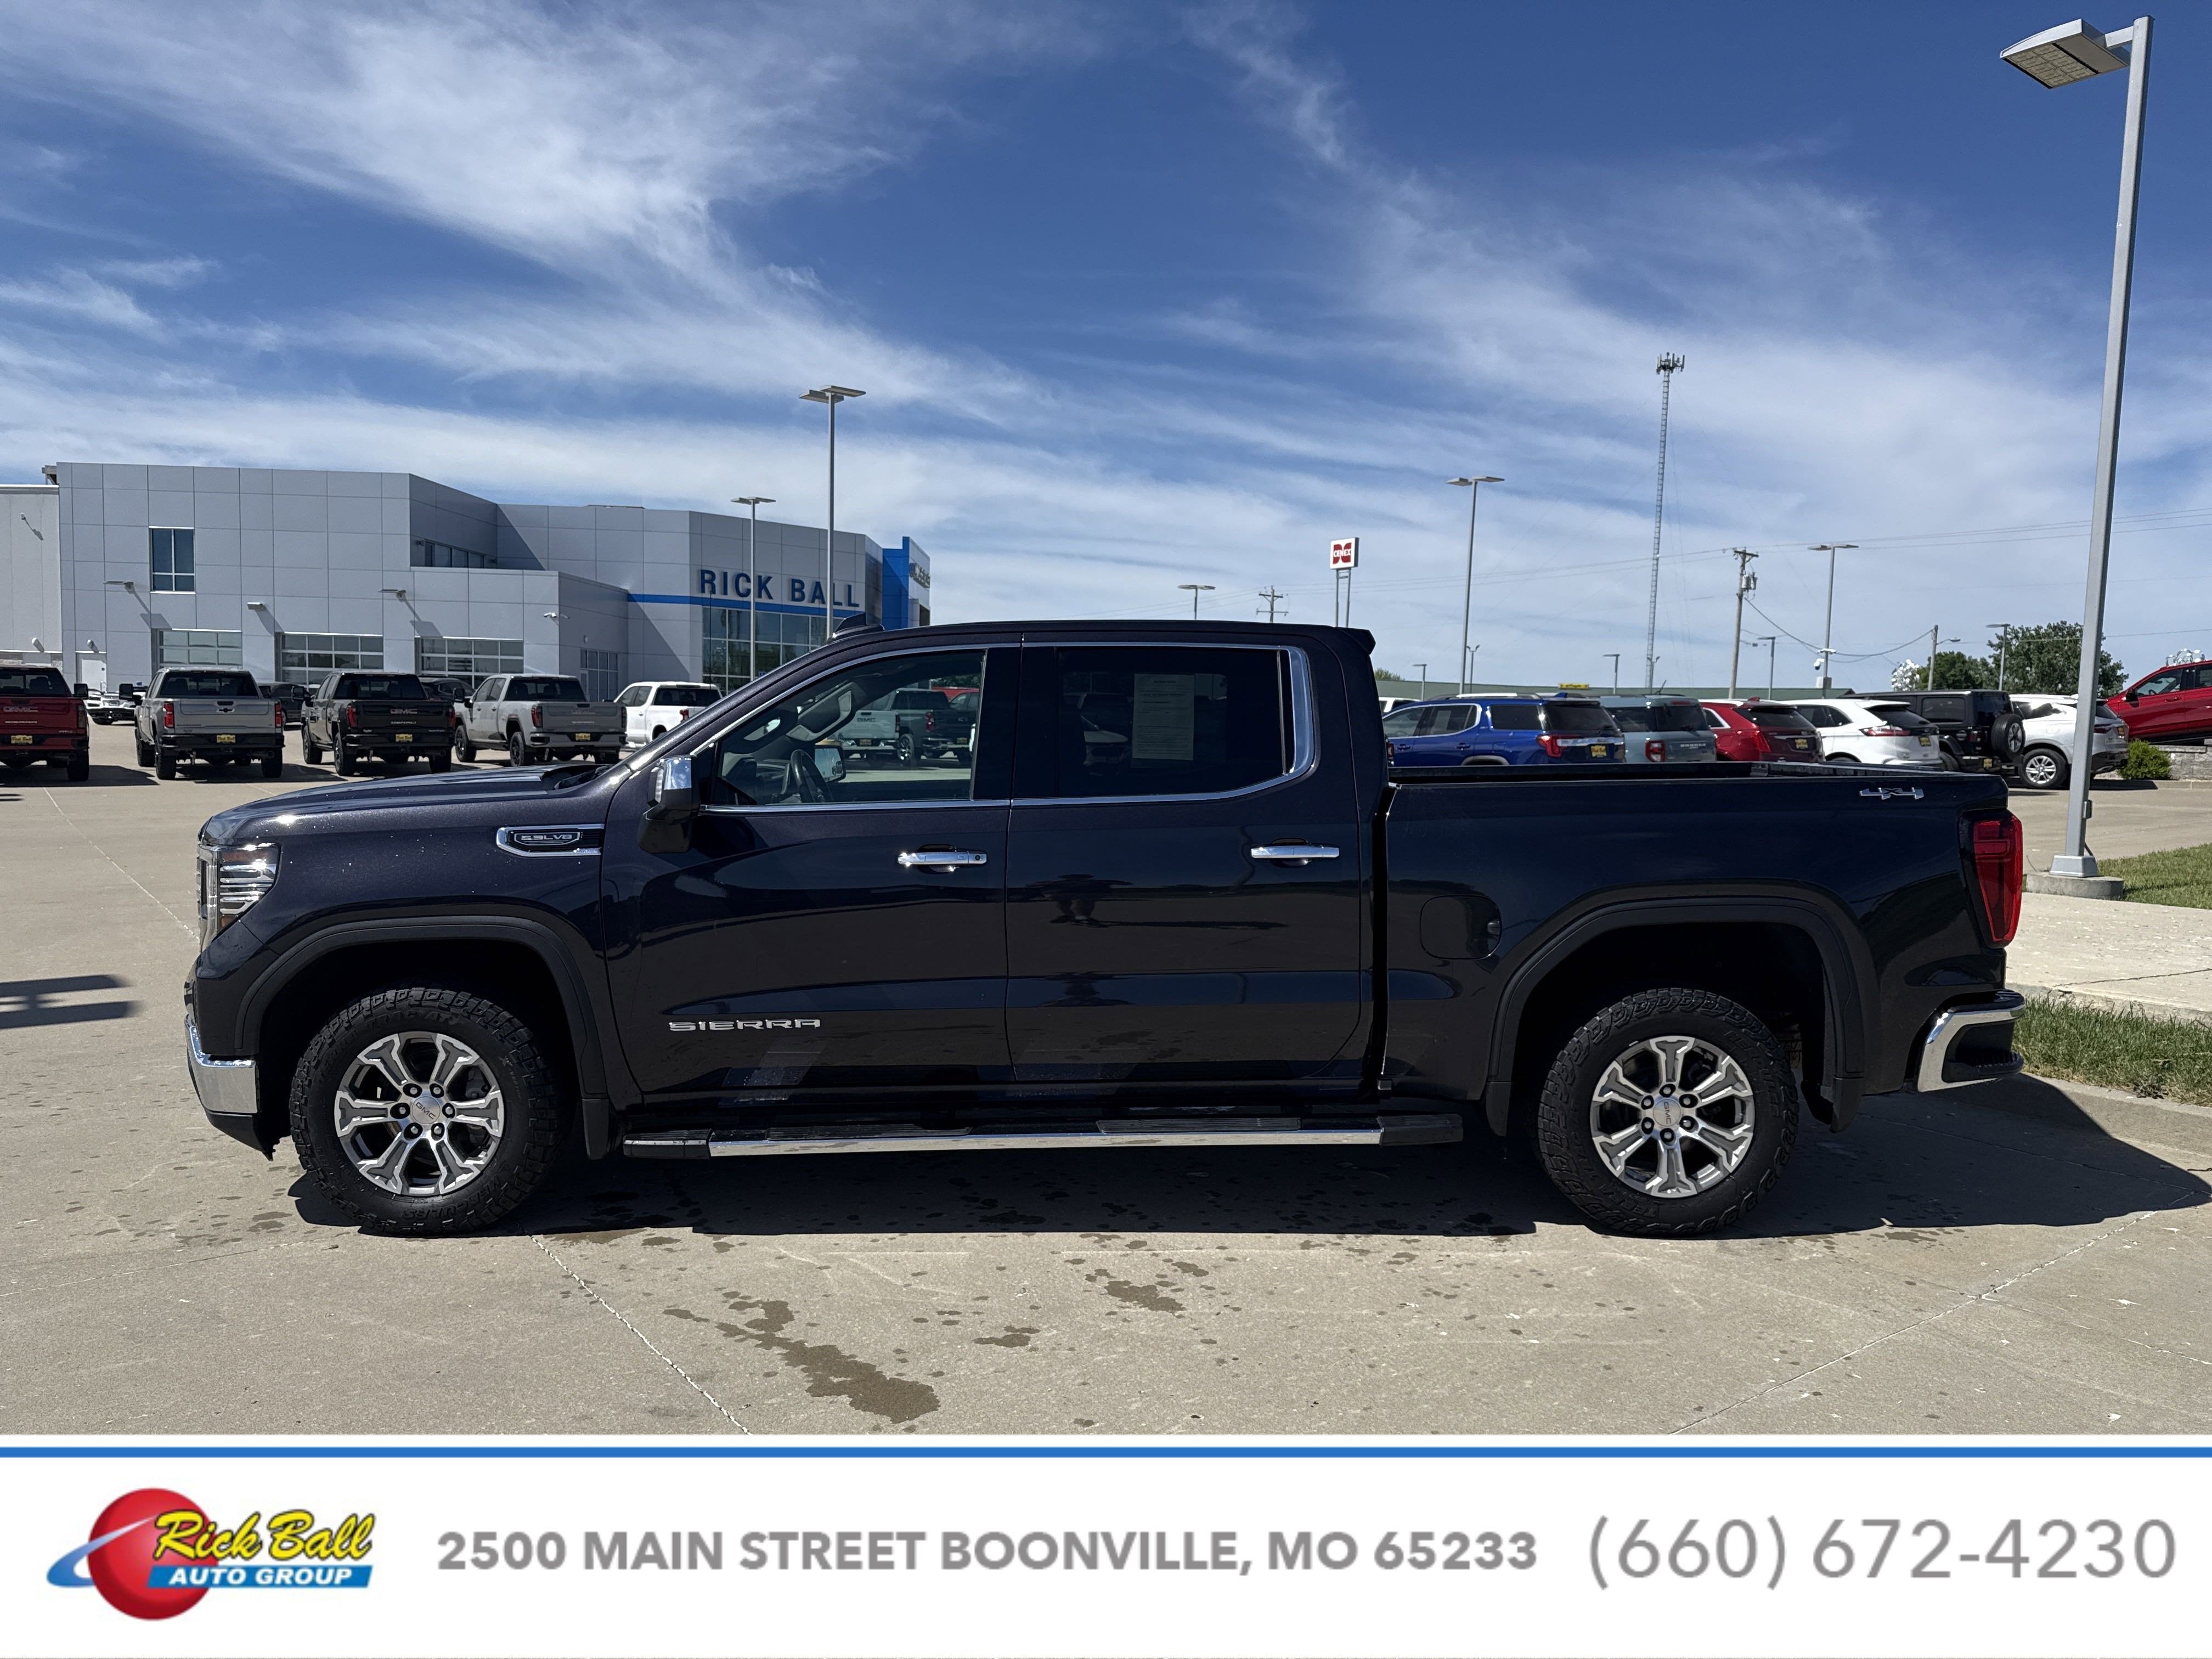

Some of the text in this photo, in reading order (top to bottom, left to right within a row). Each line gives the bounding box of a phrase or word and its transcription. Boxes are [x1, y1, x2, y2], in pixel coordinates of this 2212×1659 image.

[701, 569, 859, 607] RICK BALL
[669, 1018, 821, 1031] SIERRA
[415, 1102, 436, 1120] GMC
[1663, 1102, 1673, 1125] GMC
